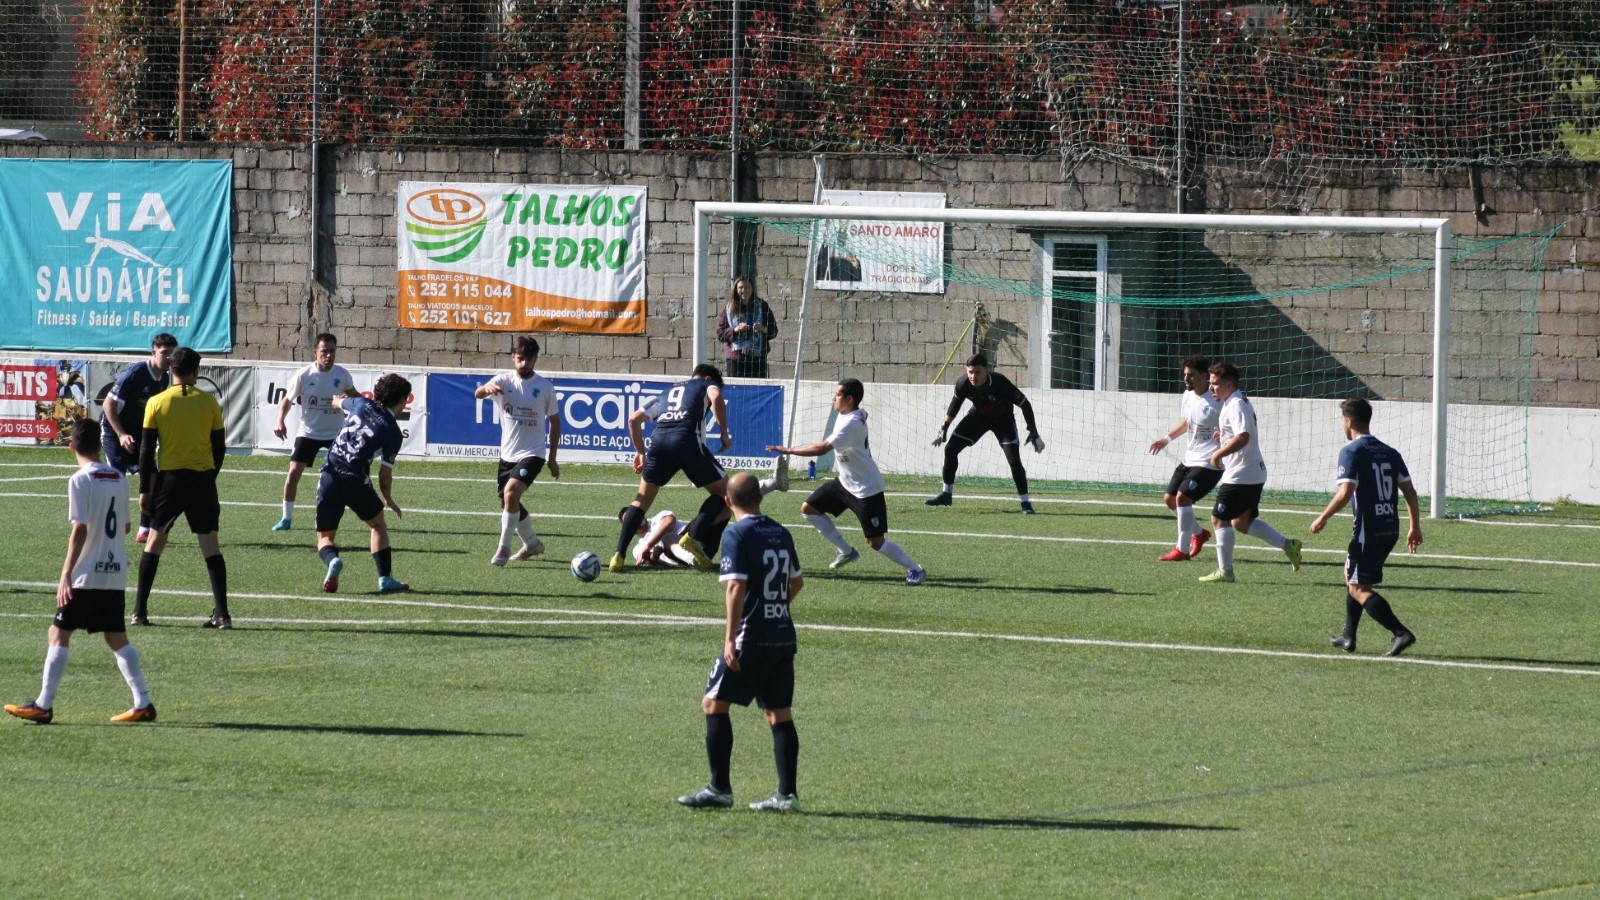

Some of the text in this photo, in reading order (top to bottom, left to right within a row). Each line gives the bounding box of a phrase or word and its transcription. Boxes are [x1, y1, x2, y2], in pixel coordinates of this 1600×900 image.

[46, 192, 176, 231] ViA
[501, 193, 636, 227] TALHOS
[850, 225, 940, 238] SANTO AMARO
[507, 236, 629, 272] PEDRO
[36, 258, 191, 304] SAUDÁVEL
[427, 274, 464, 282] FRADELOS
[871, 275, 931, 284] TRADICIONAIS
[420, 282, 512, 298] 252 115 044
[427, 302, 460, 310] VIATODOS
[525, 306, 637, 319] talhospedro@hotmail.com
[37, 309, 77, 326] Fitness
[89, 310, 122, 326] Saúde
[133, 311, 190, 327] Bem-Estar
[420, 310, 512, 326] 252 101 627
[667, 385, 686, 411] 9
[0, 423, 51, 434] 910 953 156
[593, 435, 606, 446] DE
[608, 436, 631, 450] AÇO
[437, 446, 500, 457] WWW.MERCAIN
[625, 454, 635, 462] 25
[754, 459, 772, 468] 949
[1371, 462, 1393, 500] 16
[104, 496, 117, 539] 6
[763, 549, 790, 600] 23
